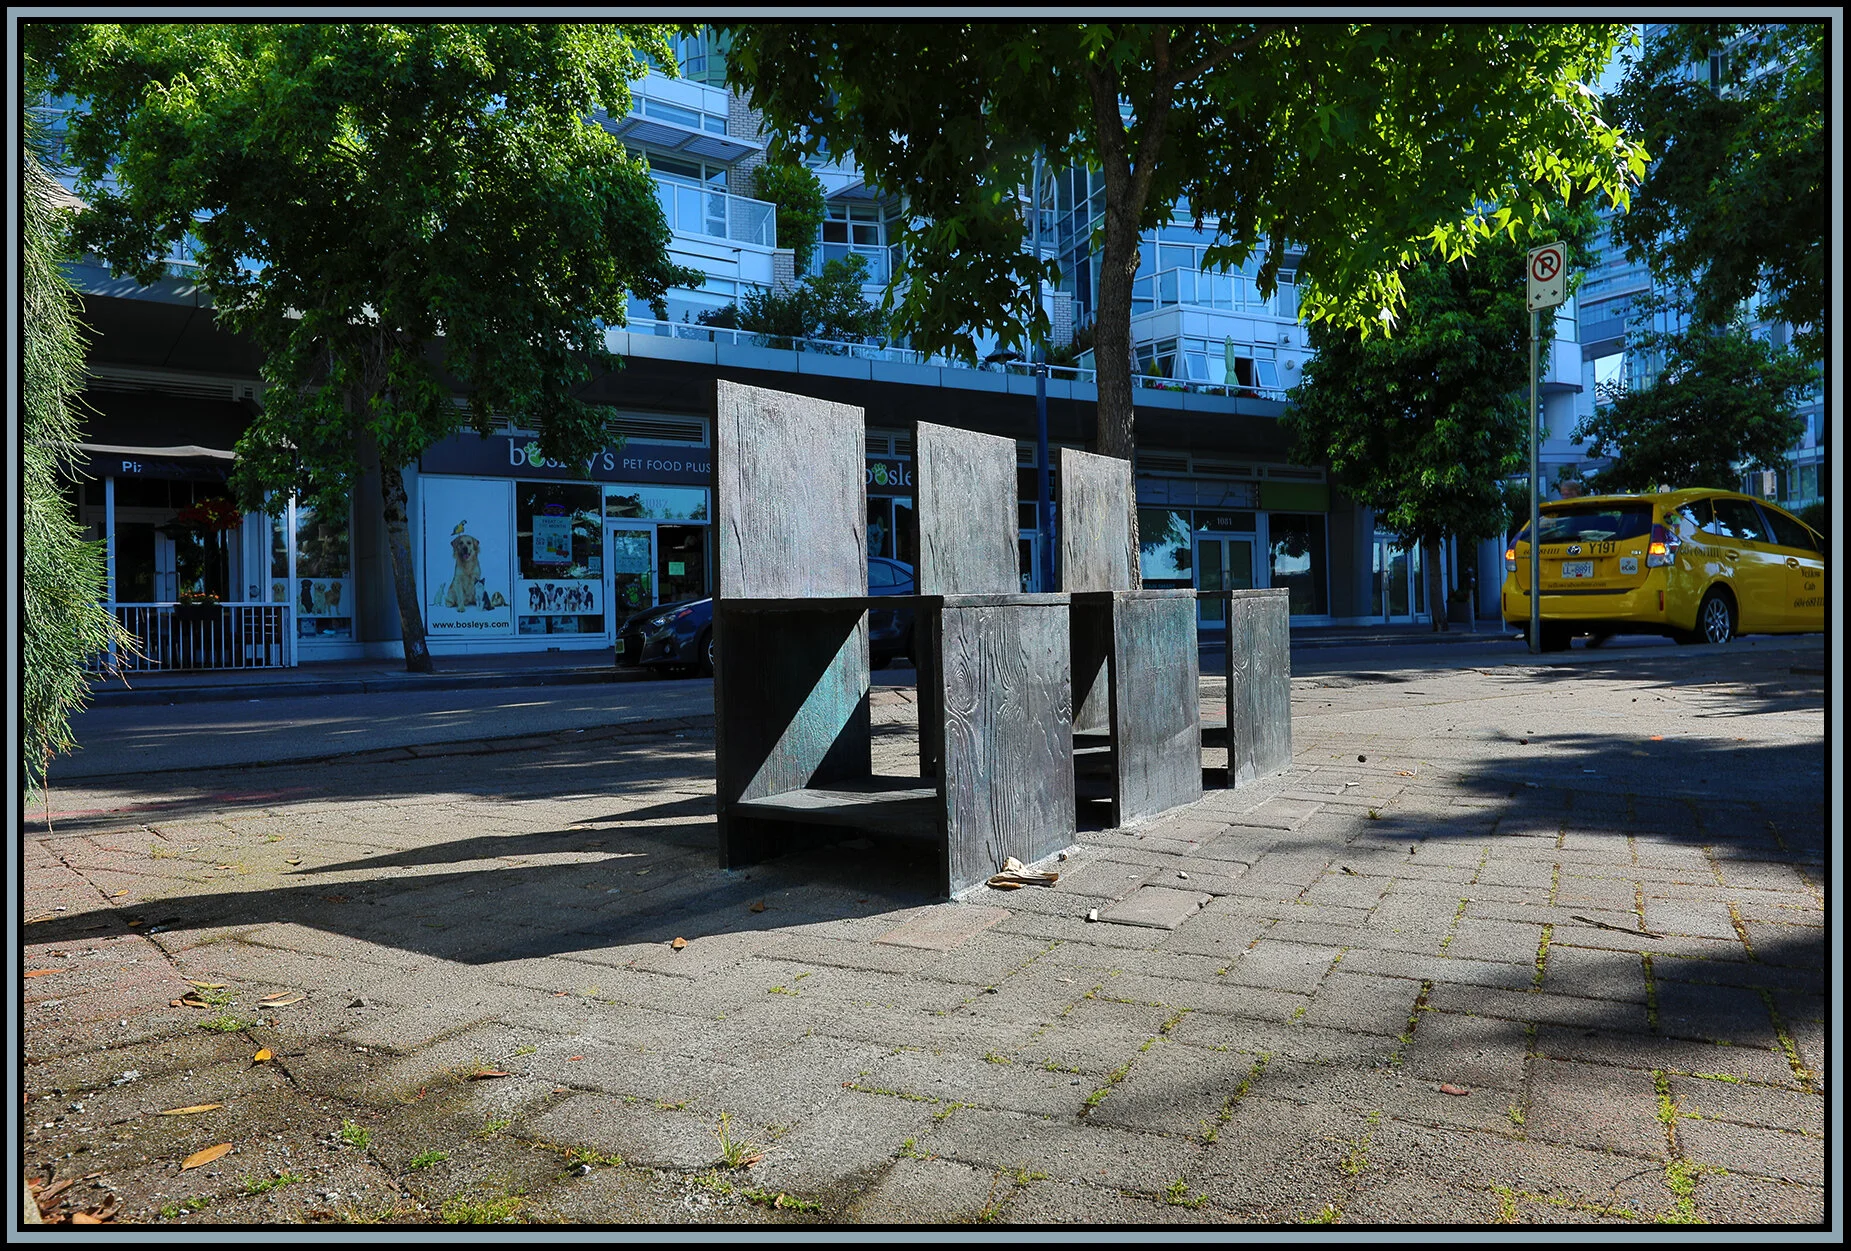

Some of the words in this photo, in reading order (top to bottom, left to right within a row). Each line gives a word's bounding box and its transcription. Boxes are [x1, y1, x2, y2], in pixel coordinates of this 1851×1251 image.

[623, 458, 643, 470] PET
[647, 459, 682, 471] FOOD
[686, 461, 711, 473] PLUS
[1587, 542, 1616, 554] Y191
[432, 620, 510, 630] www.bosleys.com
